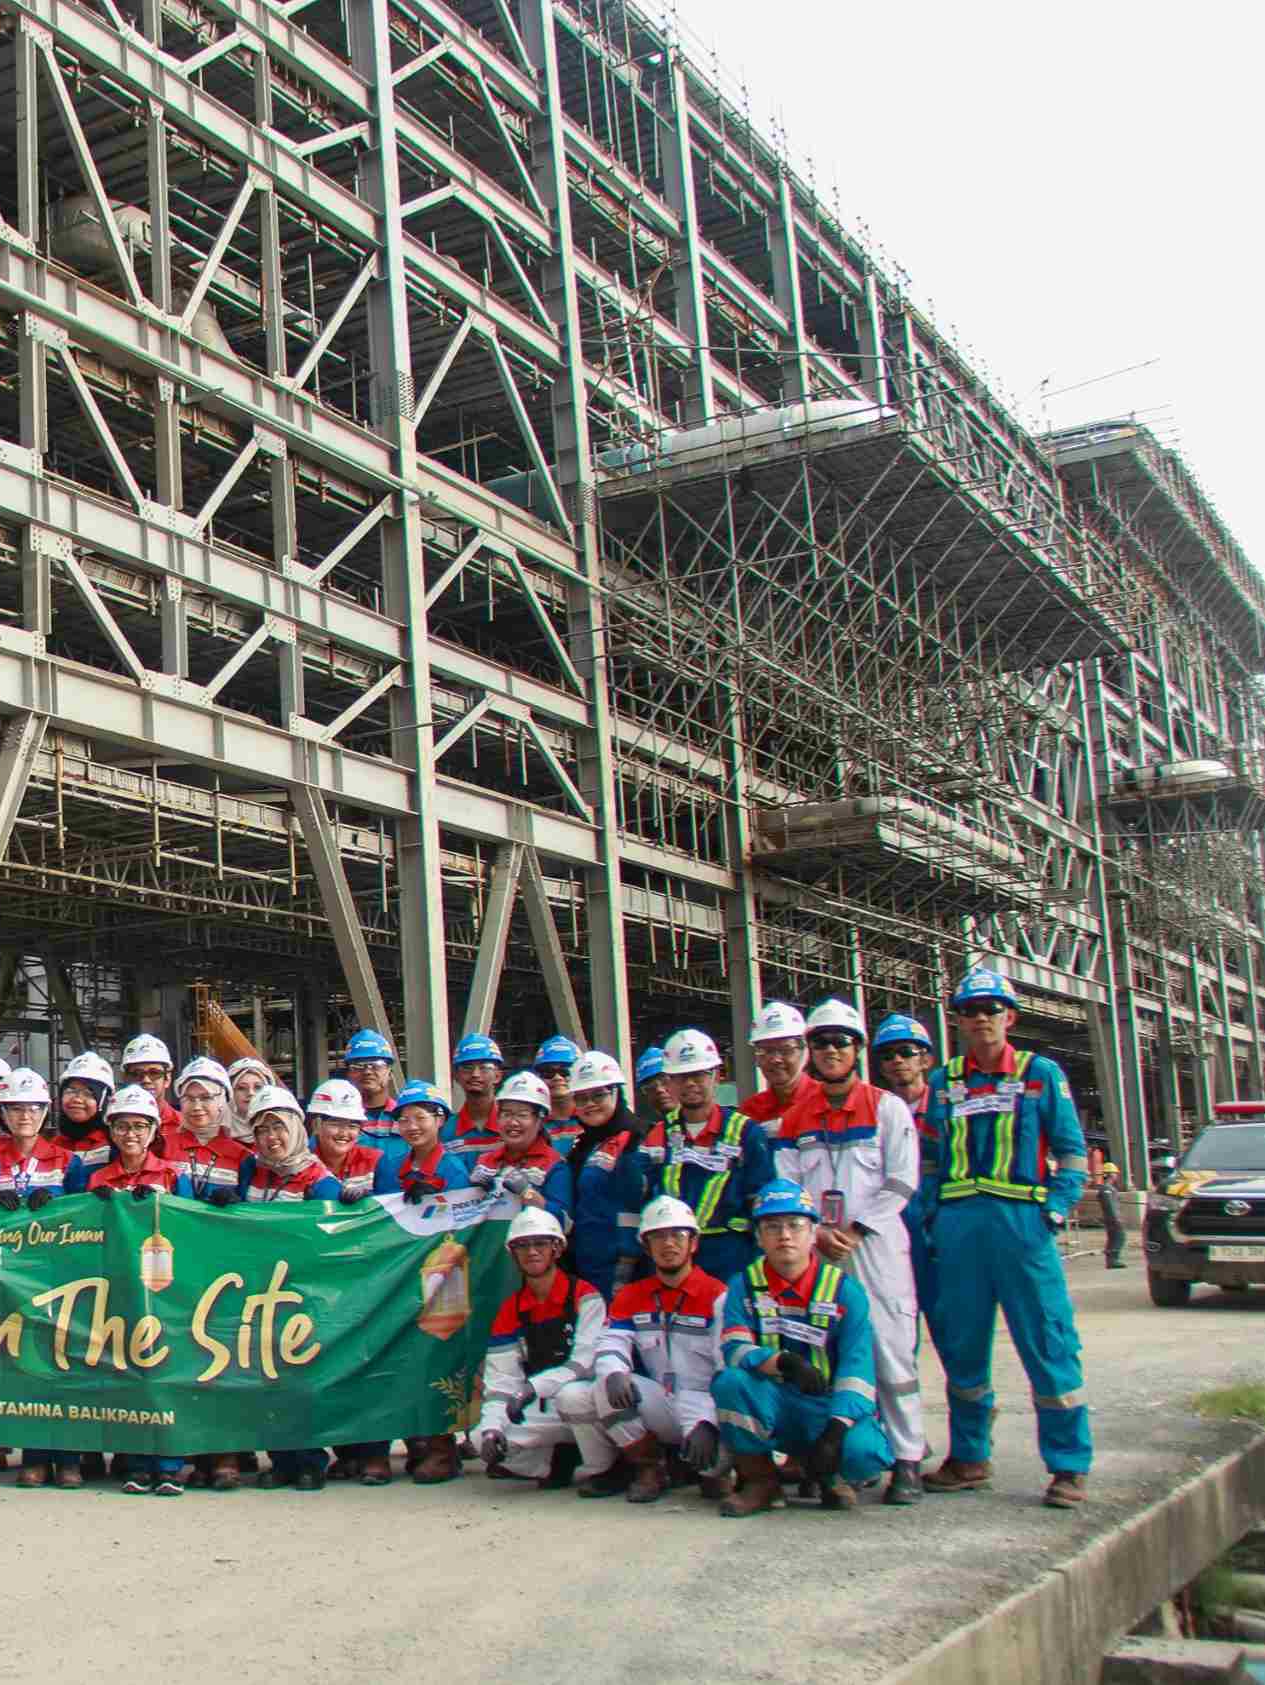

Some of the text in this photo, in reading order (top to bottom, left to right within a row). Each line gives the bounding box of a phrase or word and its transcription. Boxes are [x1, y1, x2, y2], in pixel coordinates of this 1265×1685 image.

[27, 1220, 57, 1245] Our
[32, 1277, 169, 1370] The
[191, 1260, 321, 1382] Site
[68, 1405, 176, 1425] BALIKPAPAN
